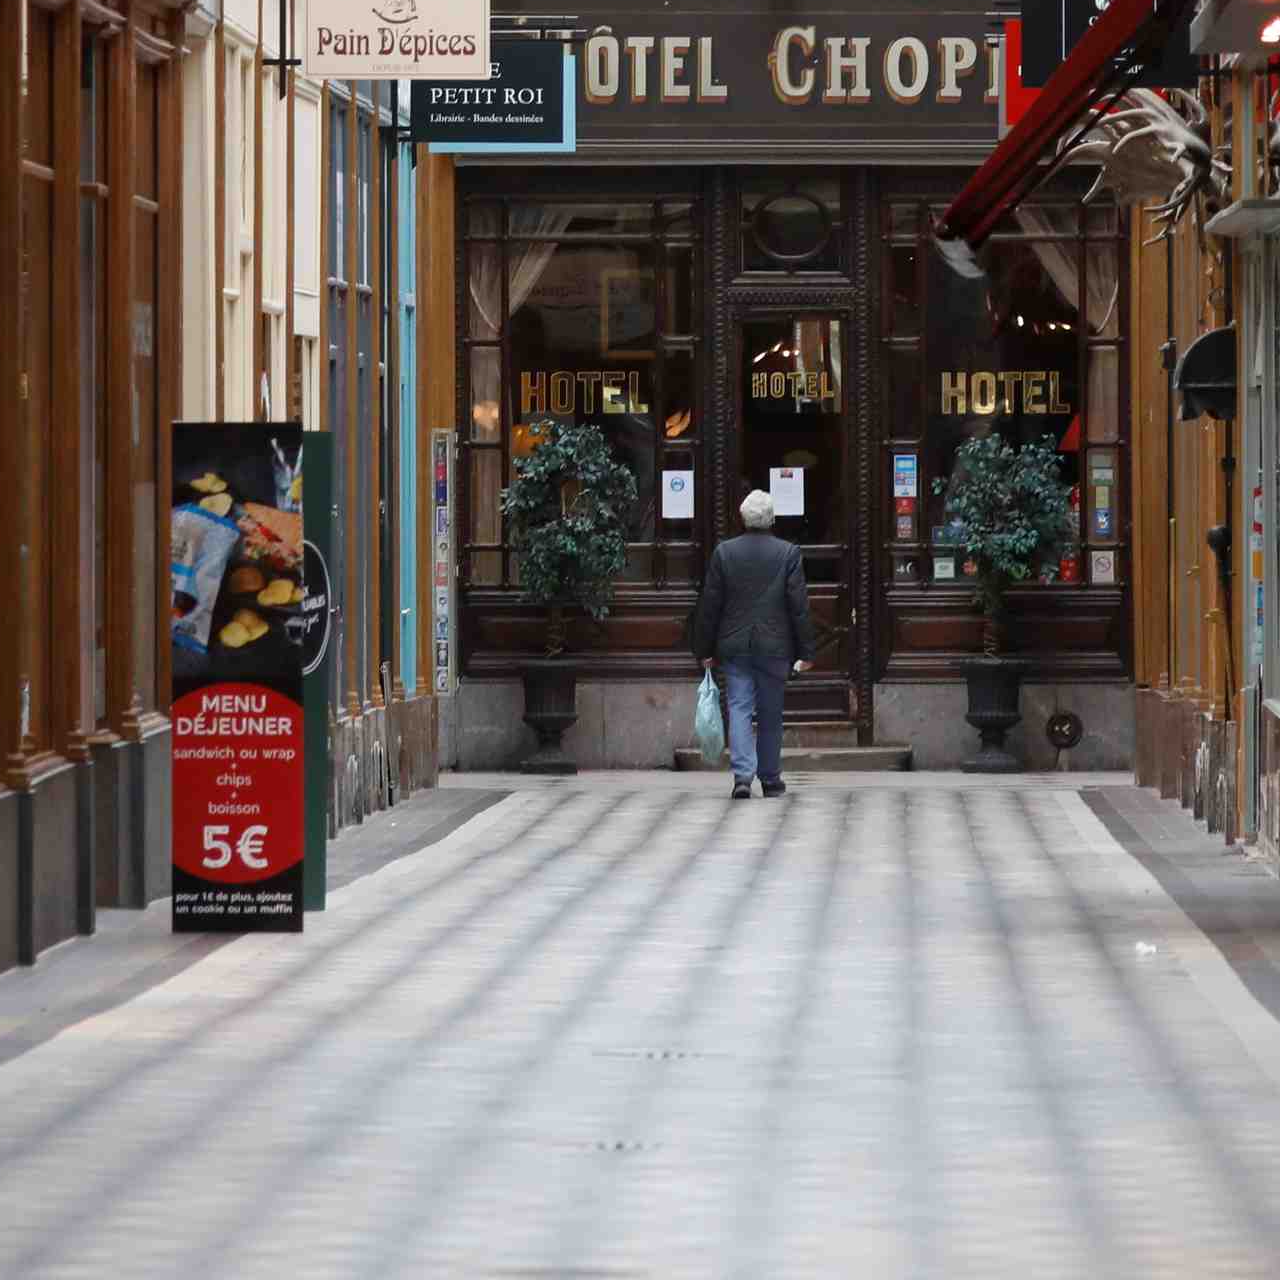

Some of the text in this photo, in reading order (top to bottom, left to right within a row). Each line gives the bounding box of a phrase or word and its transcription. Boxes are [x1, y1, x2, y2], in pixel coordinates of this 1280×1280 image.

[316, 26, 476, 63] Pain D'épices
[489, 62, 502, 79] E
[585, 25, 1000, 105] ÔTEL CHOPI
[430, 87, 545, 105] PETIT ROI
[430, 113, 466, 124] Librairie
[473, 113, 504, 124] Bandes
[505, 113, 545, 124] dessinées
[520, 370, 650, 414] HOTEL
[751, 371, 834, 399] HOTEL
[941, 370, 1072, 415] HOTEL
[201, 694, 267, 713] MENU
[176, 712, 293, 736] DÉJEUNER
[173, 746, 296, 762] sandwich ou wrap
[215, 773, 252, 787] chips
[207, 801, 261, 815] boisson
[202, 824, 269, 869] 5€
[176, 893, 200, 903] pour
[216, 891, 228, 902] de
[256, 891, 293, 903] ajoutez
[176, 904, 293, 914] un cookie ou un muffin
